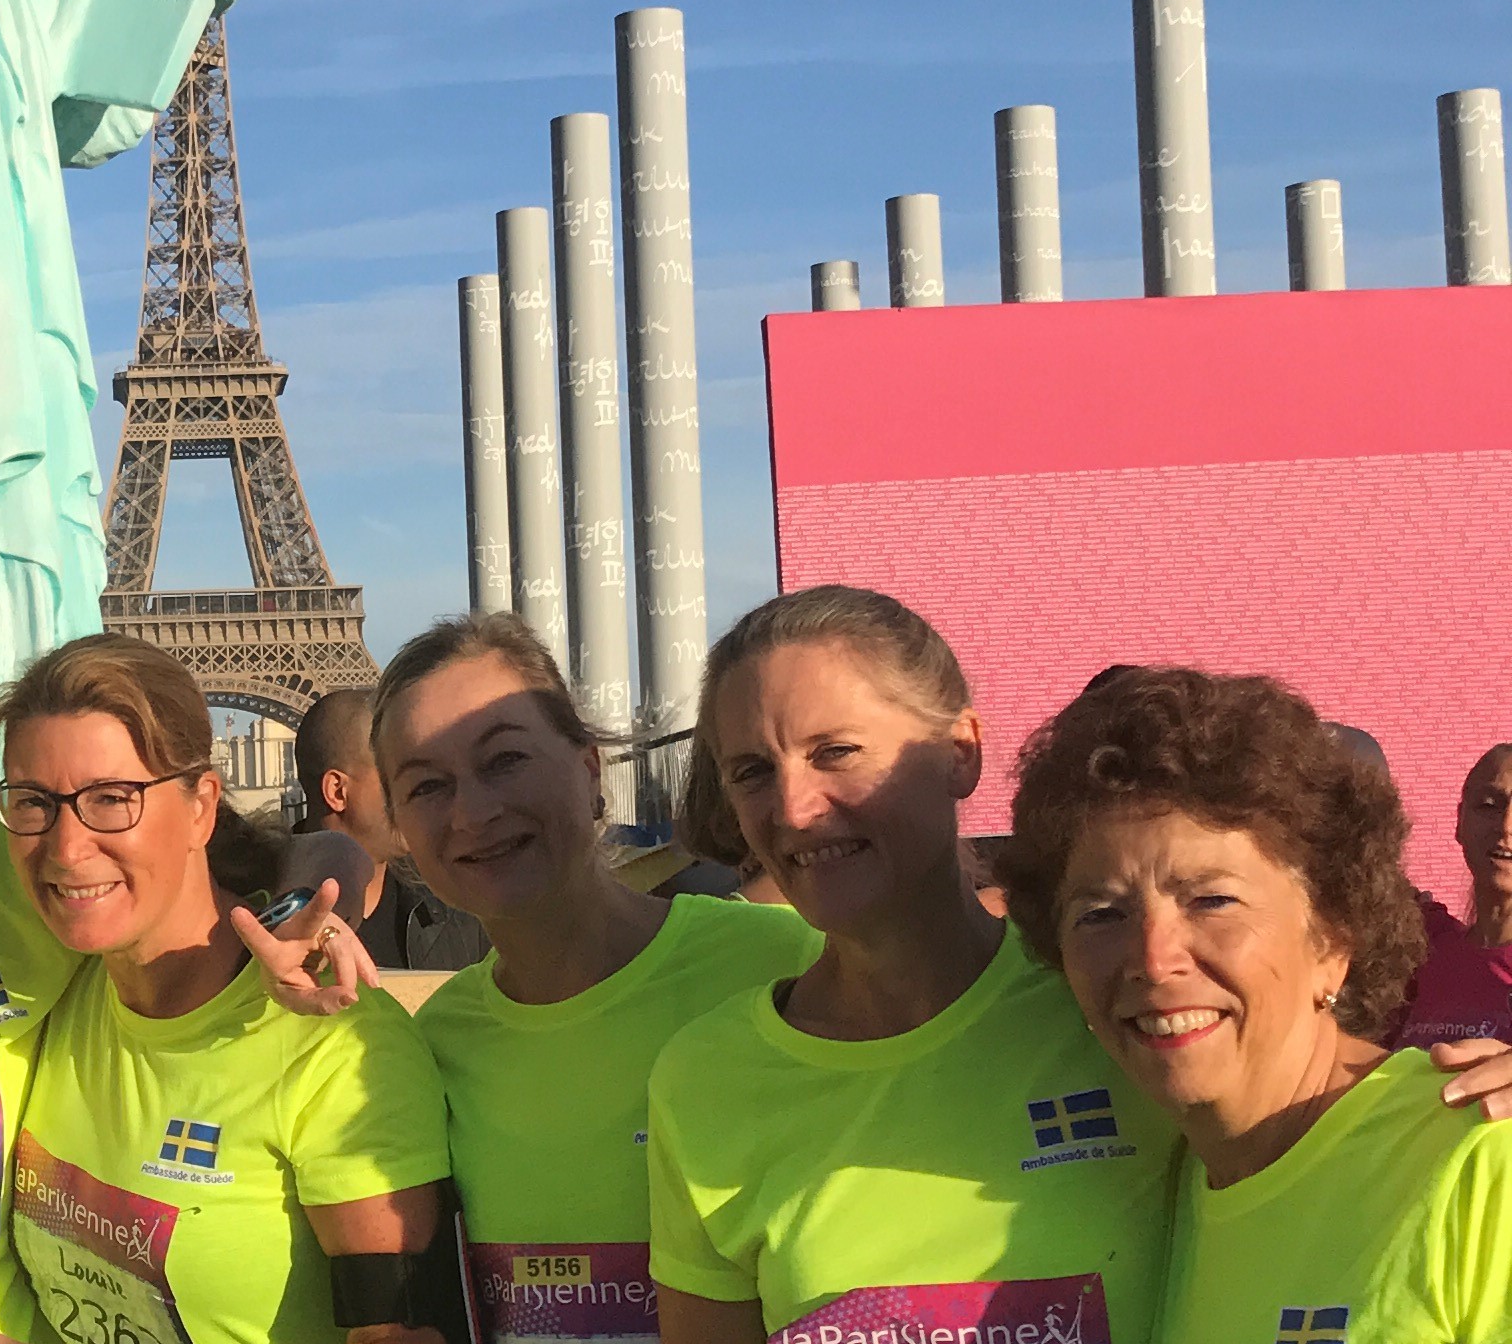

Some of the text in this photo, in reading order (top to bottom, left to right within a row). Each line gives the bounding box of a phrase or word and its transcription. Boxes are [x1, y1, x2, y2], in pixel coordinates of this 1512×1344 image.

[141, 1163, 235, 1185] Ambassade de Suède
[59, 1245, 129, 1300] Louise
[526, 1257, 582, 1277] 5156
